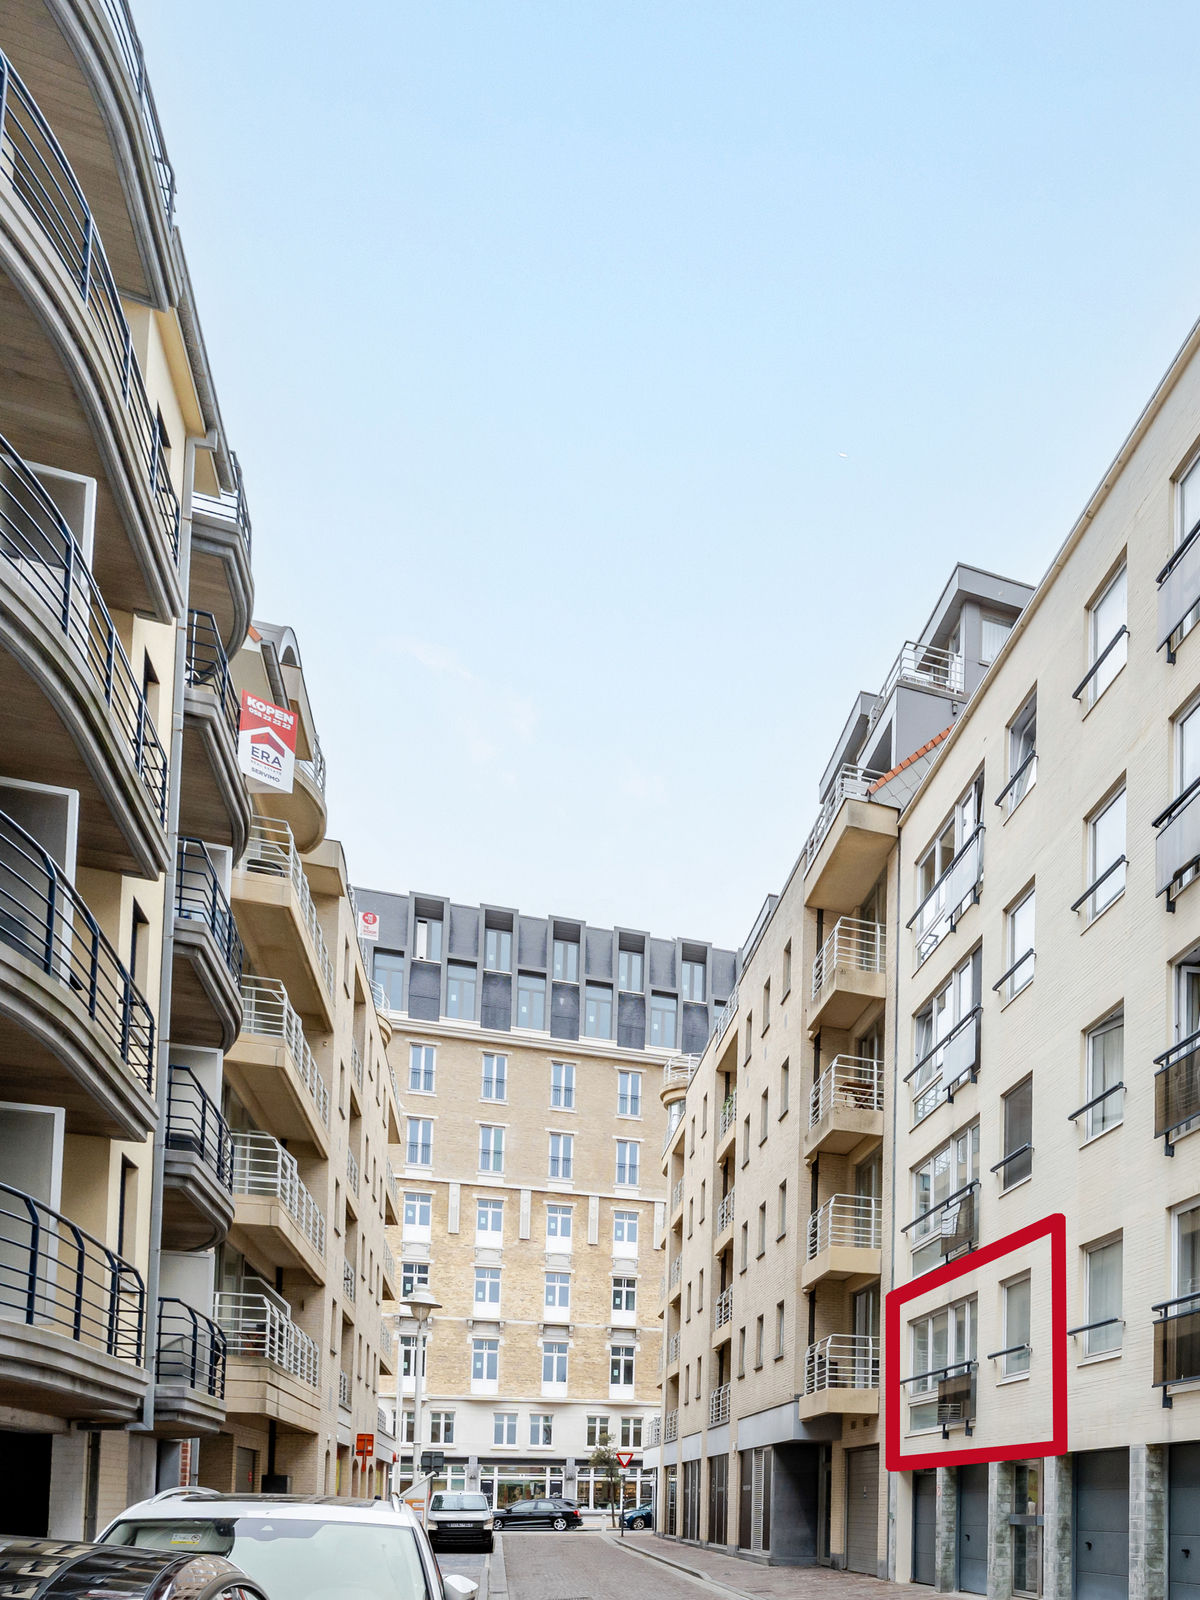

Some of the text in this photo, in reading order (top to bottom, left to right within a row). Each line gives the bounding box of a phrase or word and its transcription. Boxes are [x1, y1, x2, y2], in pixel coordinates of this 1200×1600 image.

[247, 696, 294, 725] KOPEN
[263, 714, 271, 722] 22
[272, 718, 281, 726] 22
[251, 745, 282, 768] ERA
[250, 760, 282, 776] REAL ESTATE
[251, 767, 280, 783] SERVIMO
